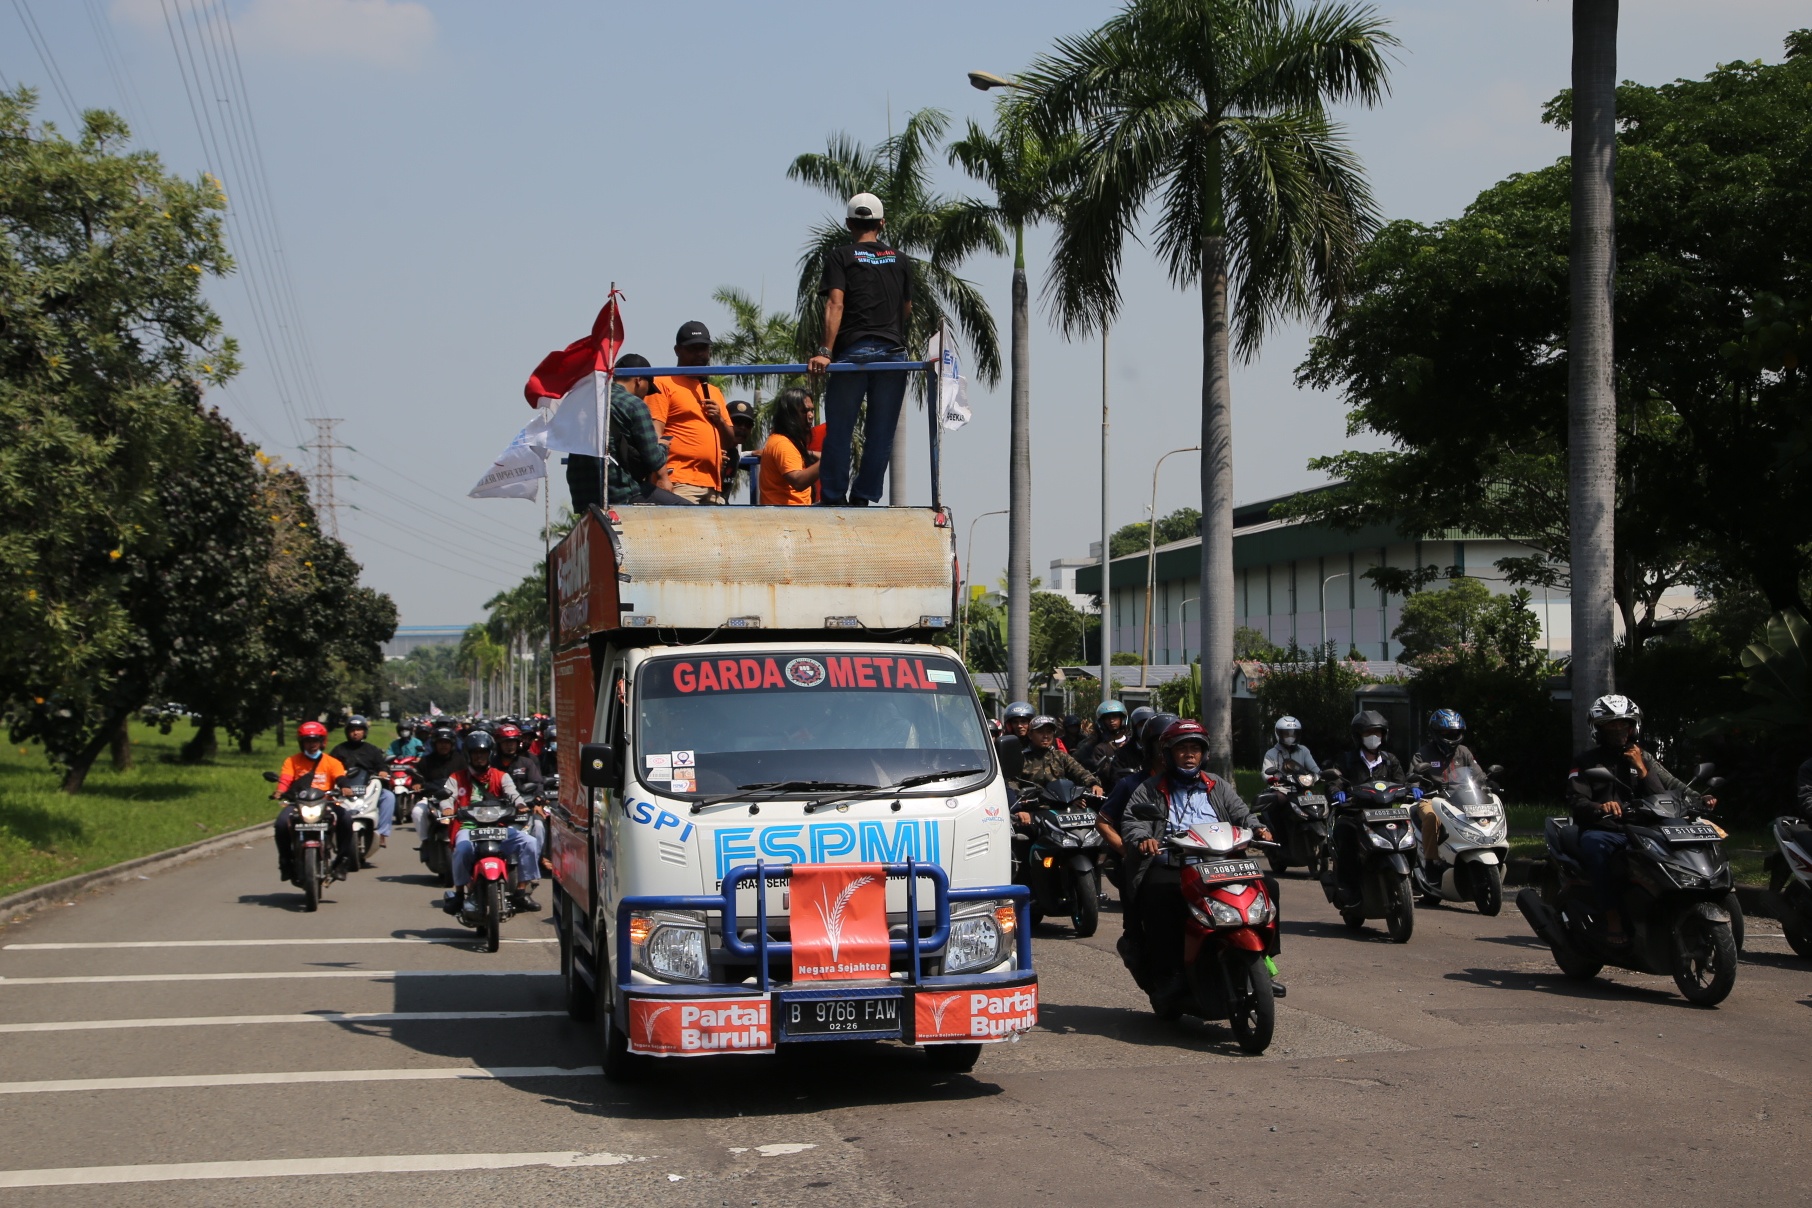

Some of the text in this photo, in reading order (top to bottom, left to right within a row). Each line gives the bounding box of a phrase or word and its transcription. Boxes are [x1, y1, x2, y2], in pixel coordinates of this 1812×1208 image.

[673, 658, 786, 693] GARDA
[825, 656, 938, 690] METAL
[622, 795, 694, 842] KSPI
[714, 819, 940, 879] FSPMI
[798, 962, 887, 976] Negara Sejahtera
[791, 1000, 896, 1023] B 9766 FAW
[970, 988, 1036, 1015] Partai
[681, 1003, 767, 1027] Partai
[970, 1011, 1036, 1037] Buruh
[681, 1026, 767, 1050] Buruh
